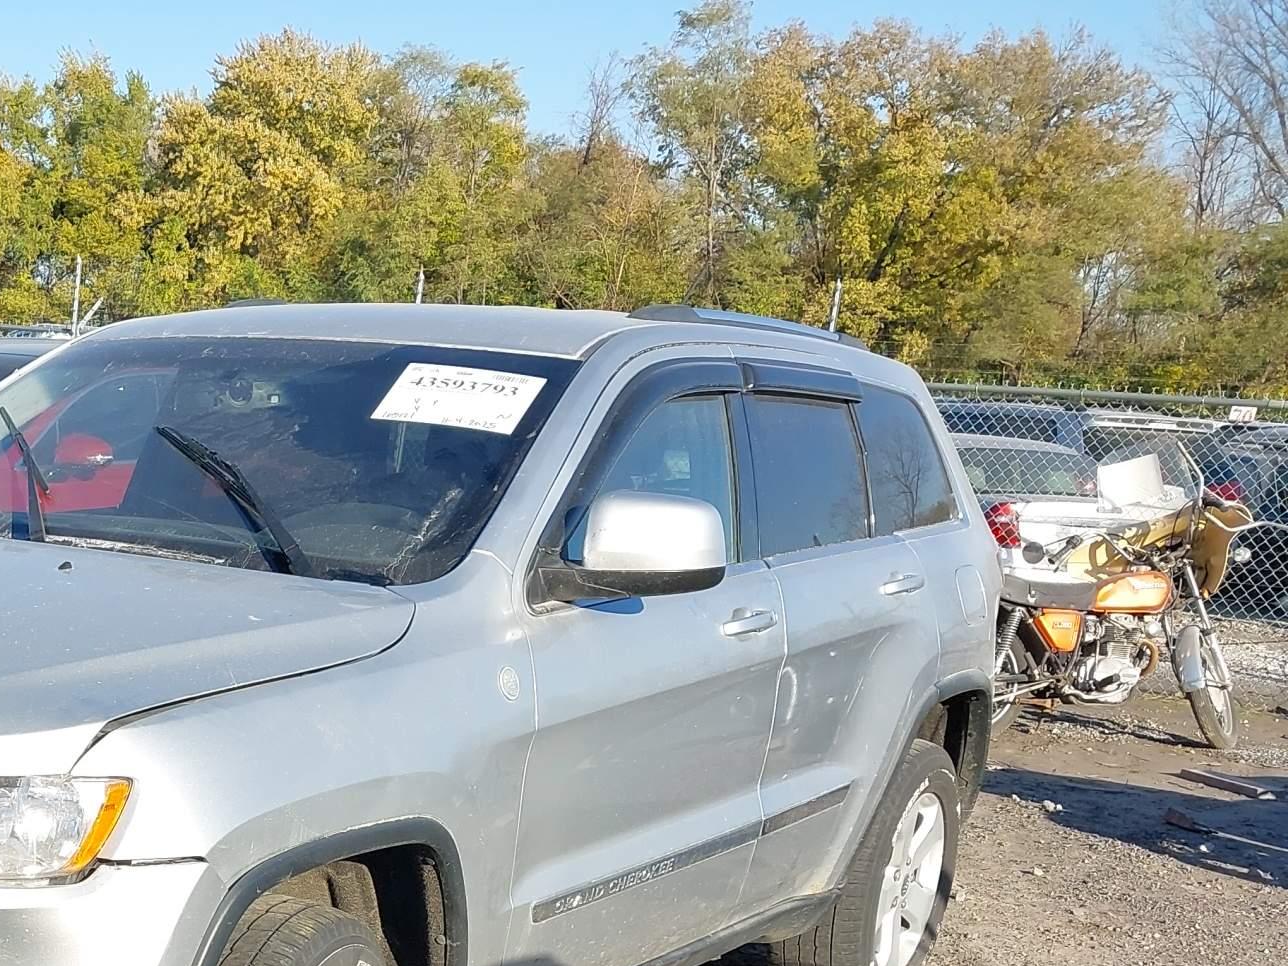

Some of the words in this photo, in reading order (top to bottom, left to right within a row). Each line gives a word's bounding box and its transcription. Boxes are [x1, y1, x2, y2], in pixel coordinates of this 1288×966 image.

[409, 376, 519, 397] 43593793
[554, 886, 606, 914] GRAND
[608, 857, 675, 893] CHEROKEE
